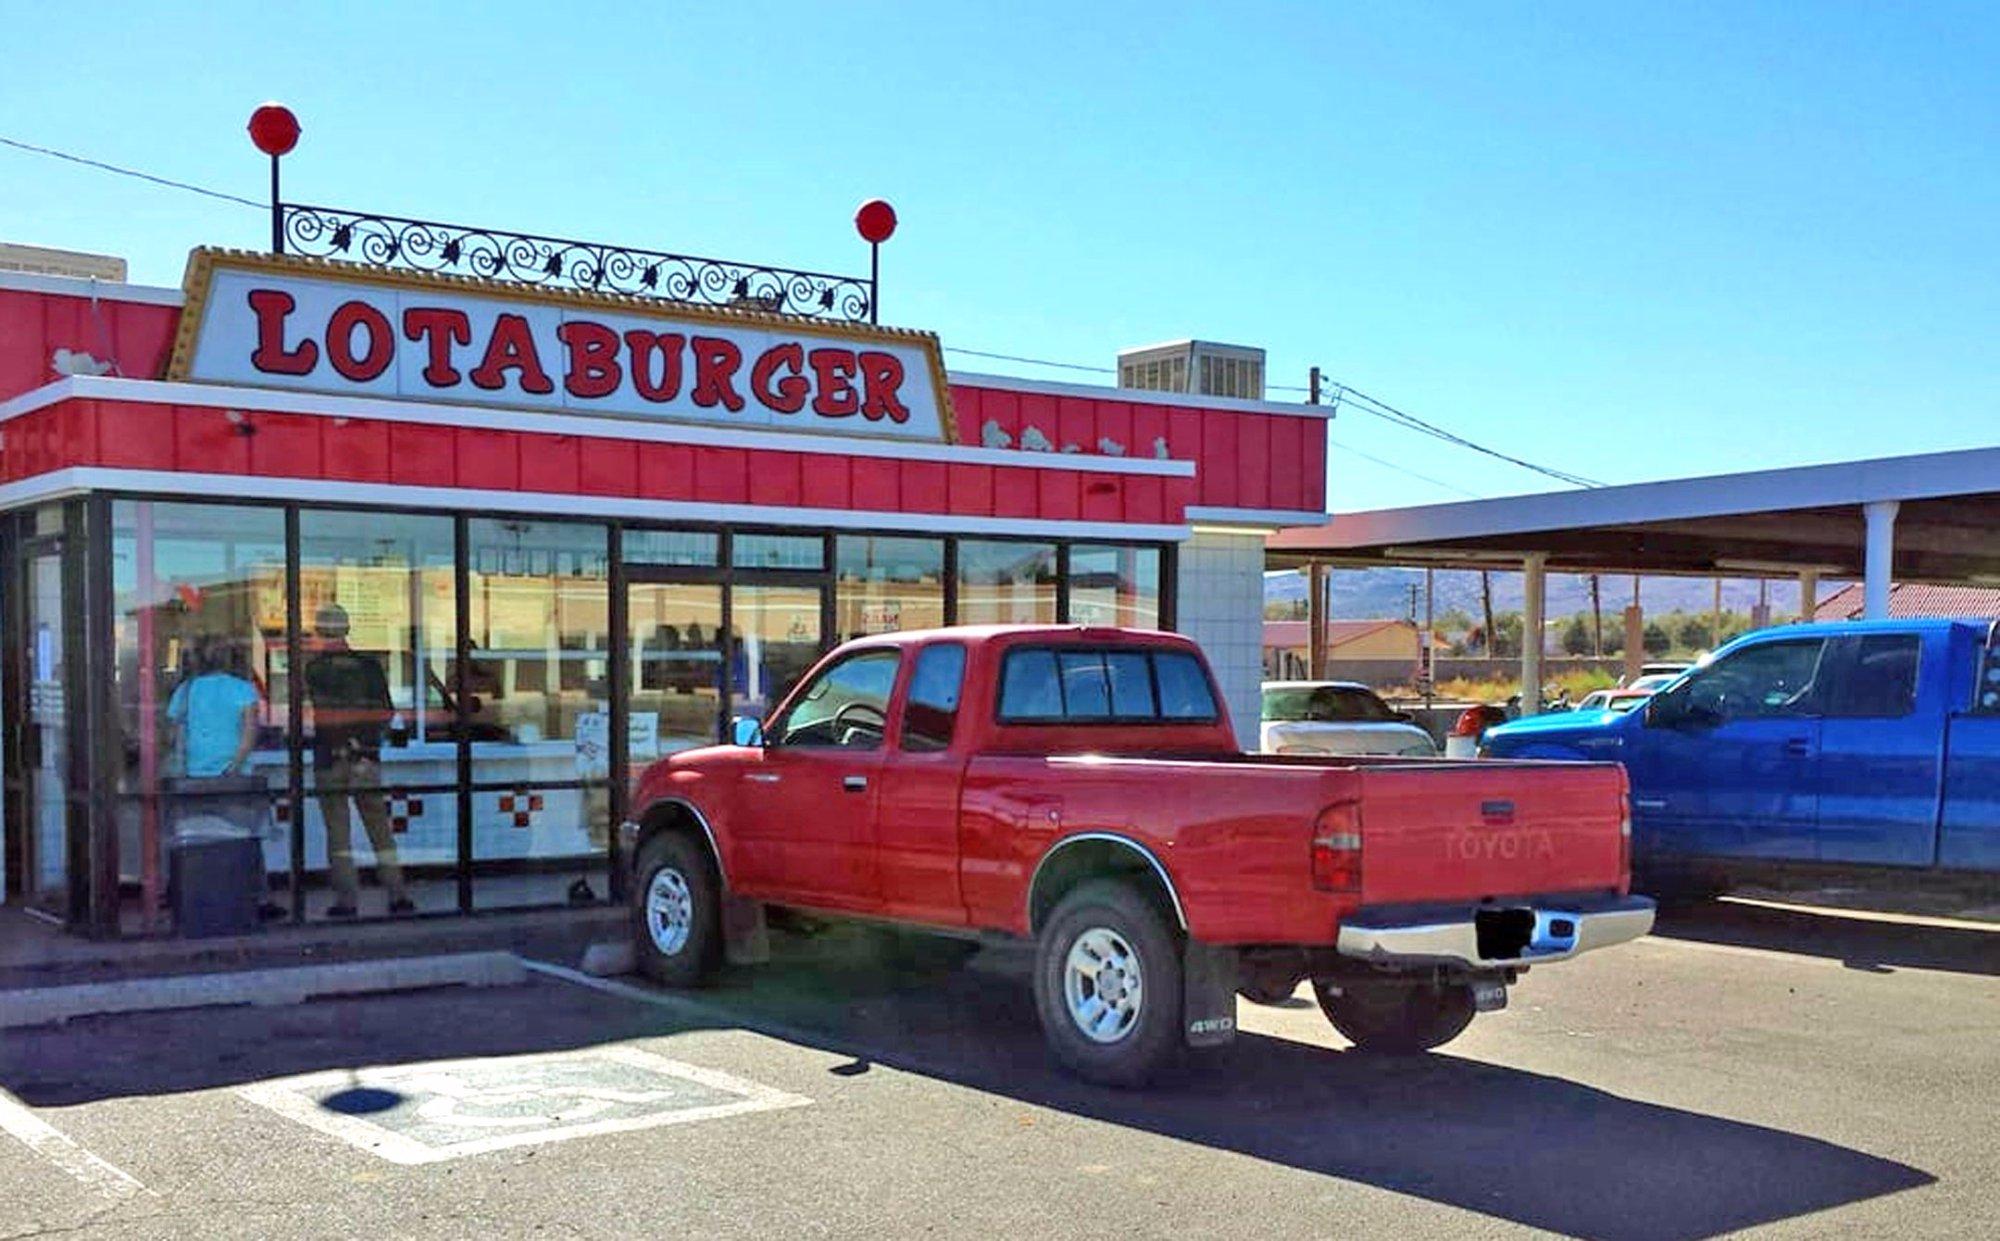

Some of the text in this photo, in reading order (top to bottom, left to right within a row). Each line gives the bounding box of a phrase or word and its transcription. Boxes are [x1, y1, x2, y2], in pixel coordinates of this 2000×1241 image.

[248, 289, 910, 424] LOTABURGER
[1443, 829, 1554, 860] TOYOTA
[1190, 1018, 1234, 1034] 4WD
